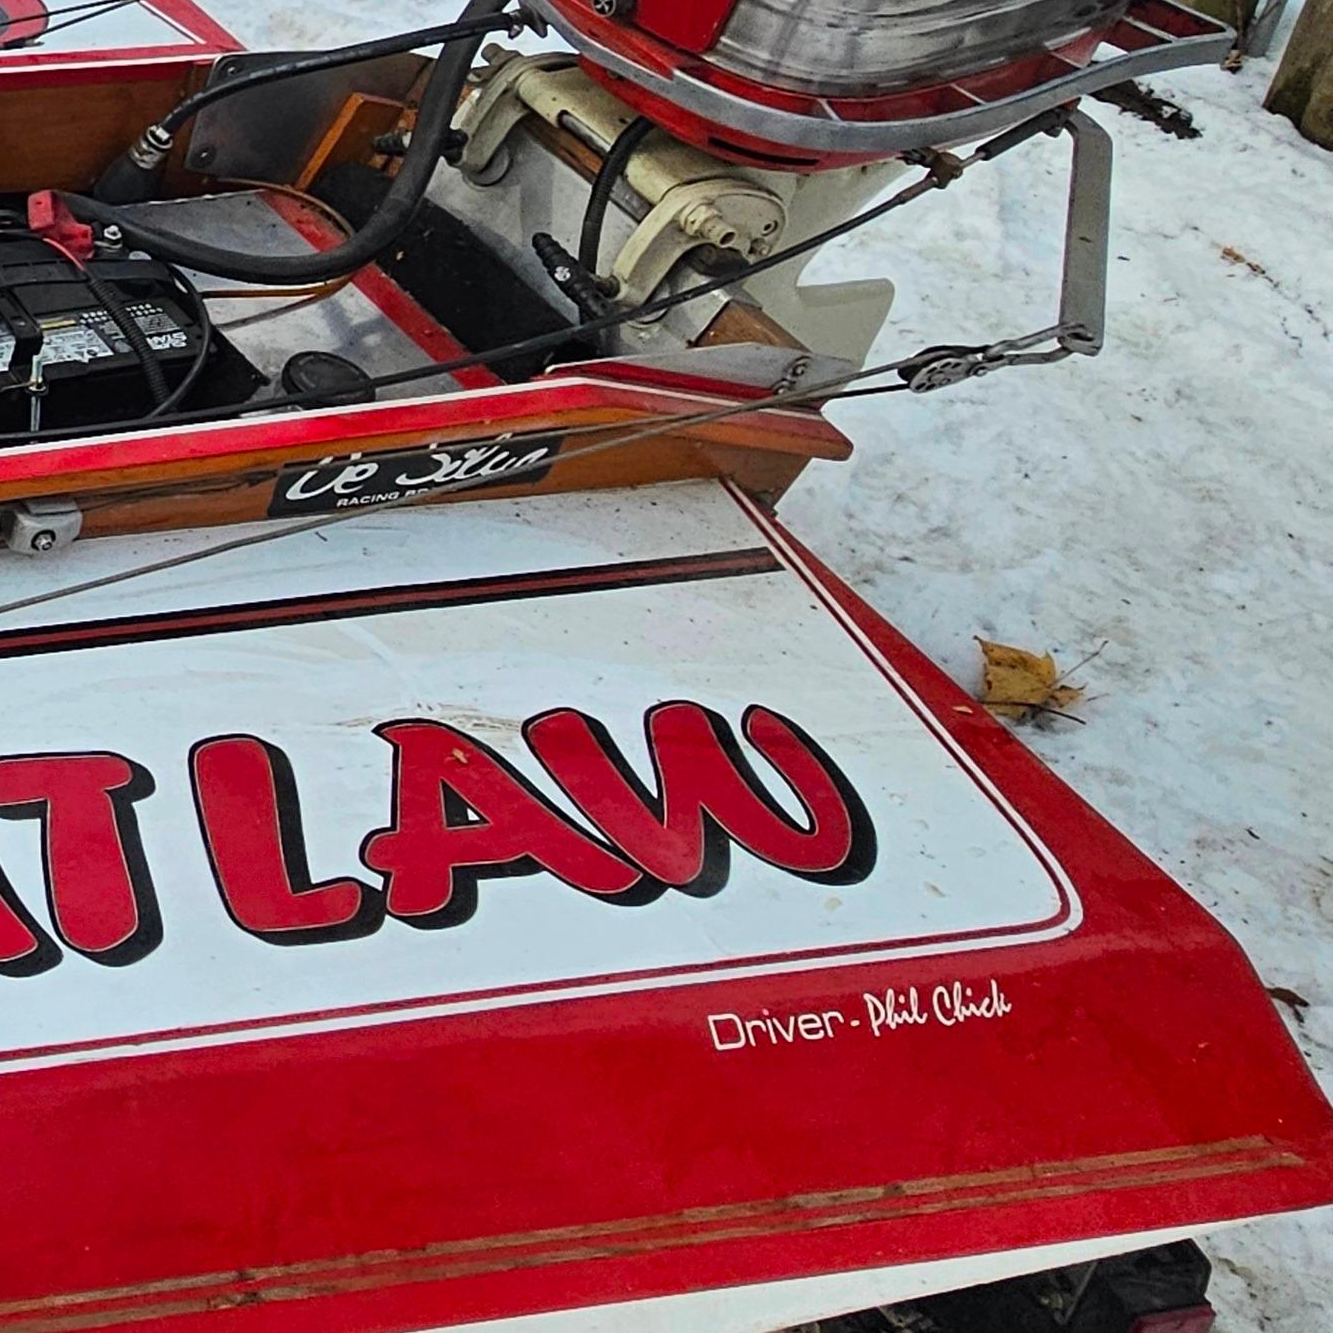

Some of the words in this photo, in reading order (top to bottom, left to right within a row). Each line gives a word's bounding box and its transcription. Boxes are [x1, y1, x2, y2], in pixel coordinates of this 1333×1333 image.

[336, 491, 400, 507] RACING
[864, 986, 928, 1037] Phil
[932, 978, 1012, 1027] Chick
